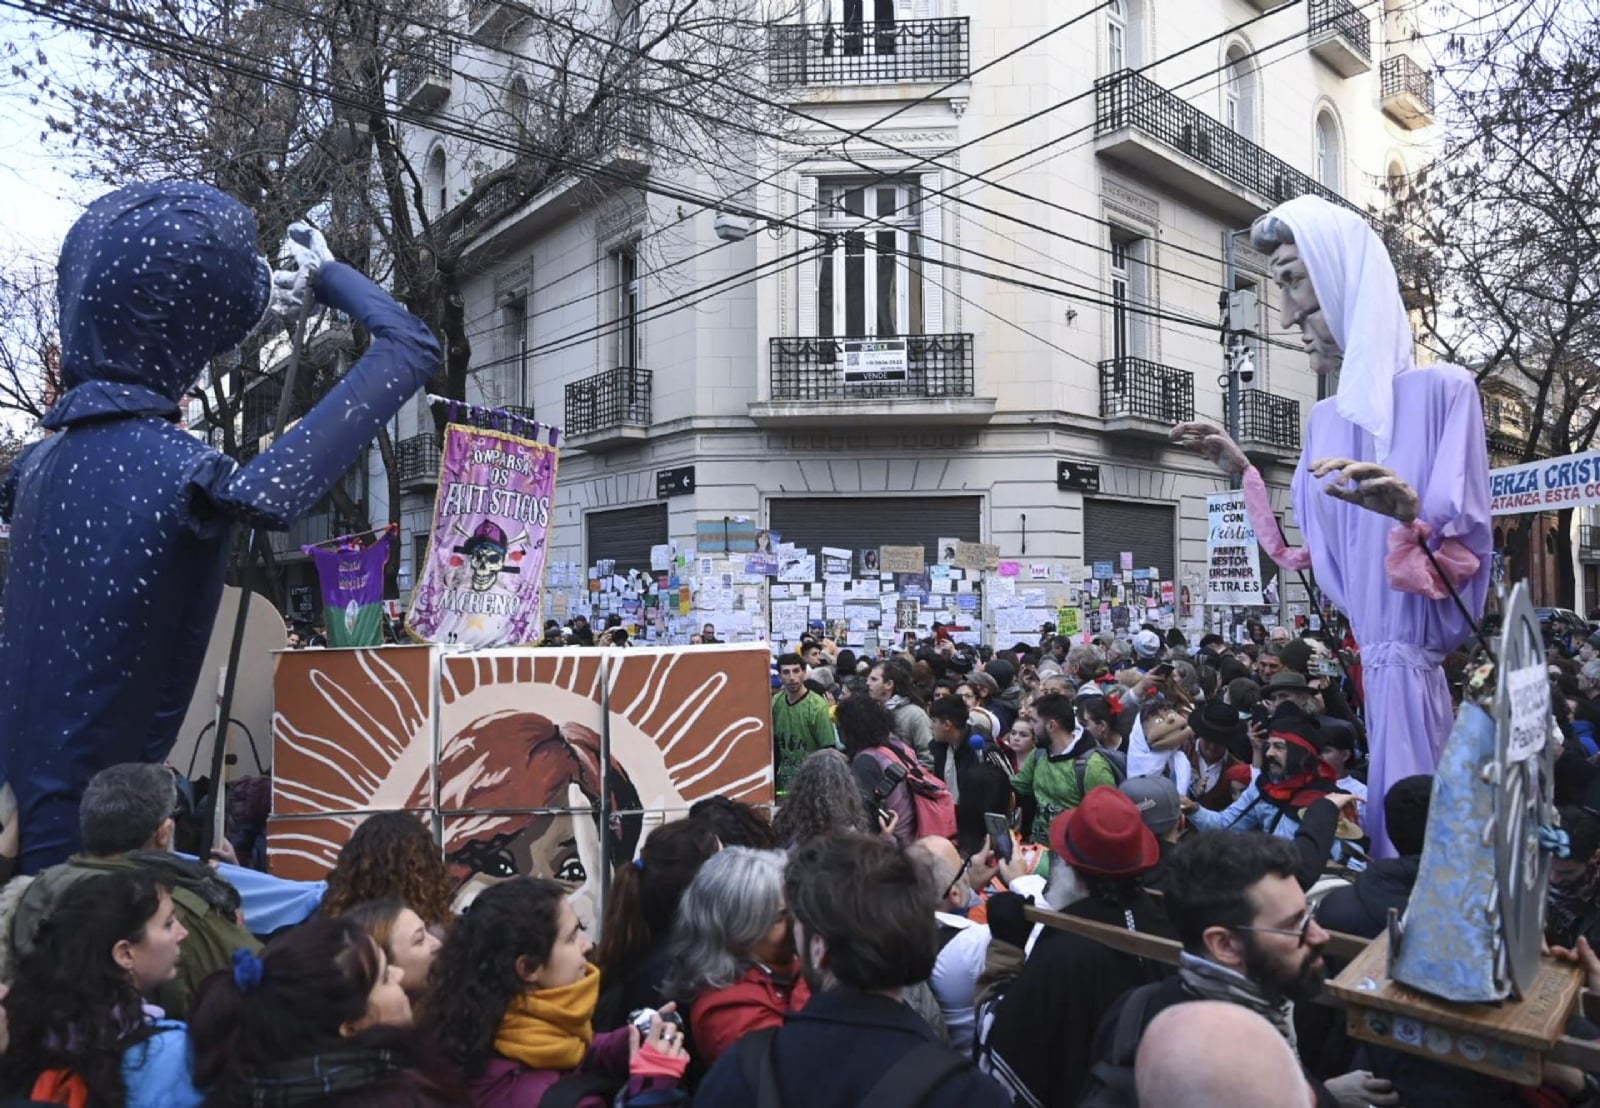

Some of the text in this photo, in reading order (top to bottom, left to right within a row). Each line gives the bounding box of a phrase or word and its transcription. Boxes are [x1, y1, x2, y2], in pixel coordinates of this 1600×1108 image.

[863, 371, 888, 380] VENDE
[472, 448, 531, 476] OMPARSA
[1545, 486, 1580, 503] ESTA
[1208, 501, 1246, 513] ARGENTI
[1222, 513, 1244, 523] CON
[1213, 546, 1248, 556] FRENTE
[1211, 556, 1249, 567] NESTOR
